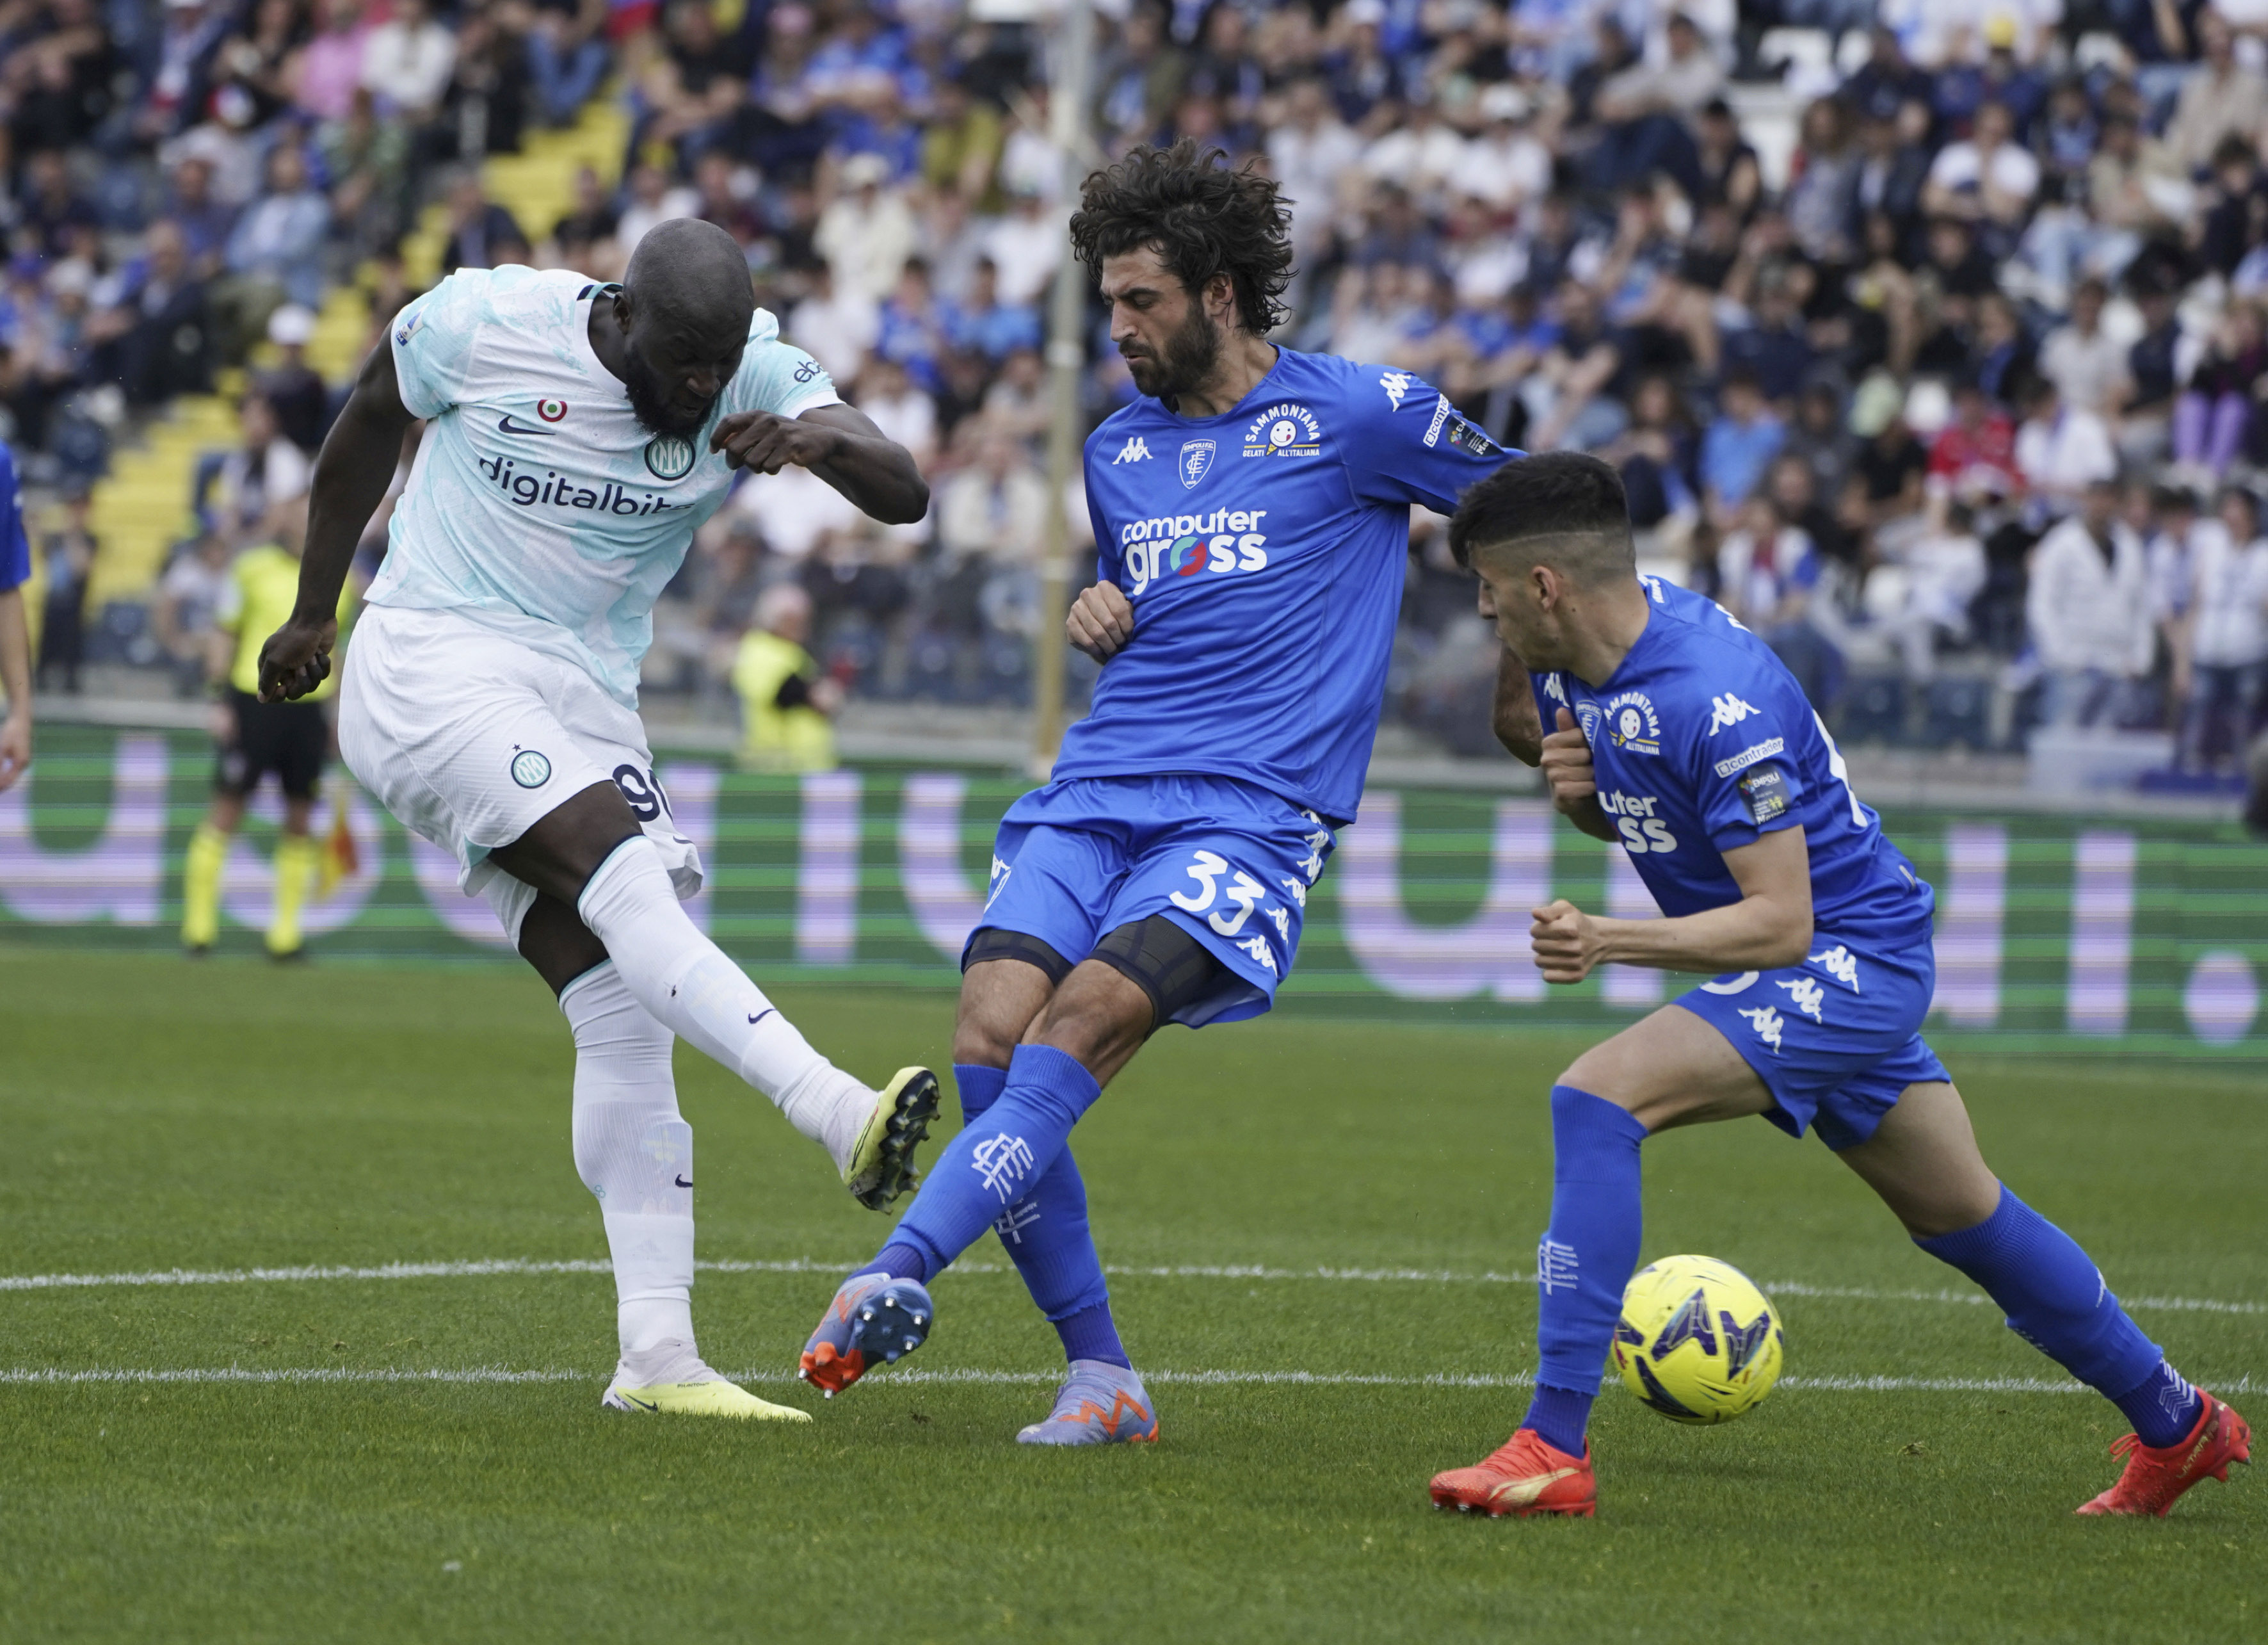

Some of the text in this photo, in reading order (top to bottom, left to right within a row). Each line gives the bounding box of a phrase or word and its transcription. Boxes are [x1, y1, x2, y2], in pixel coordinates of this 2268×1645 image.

[1244, 403, 1321, 442] SAMMONTANA
[1184, 442, 1204, 451] EMPOLI
[1243, 448, 1320, 457] GELATI ALL'ITALIANA
[1122, 506, 1267, 544] computer
[1126, 533, 1267, 596] gross
[1604, 692, 1661, 738] AMMONTANA
[1625, 741, 1660, 756] ALL'ITALIANA
[1730, 740, 1783, 769] contrader
[1753, 771, 1780, 788] EMPOLI
[1169, 850, 1266, 937] 33
